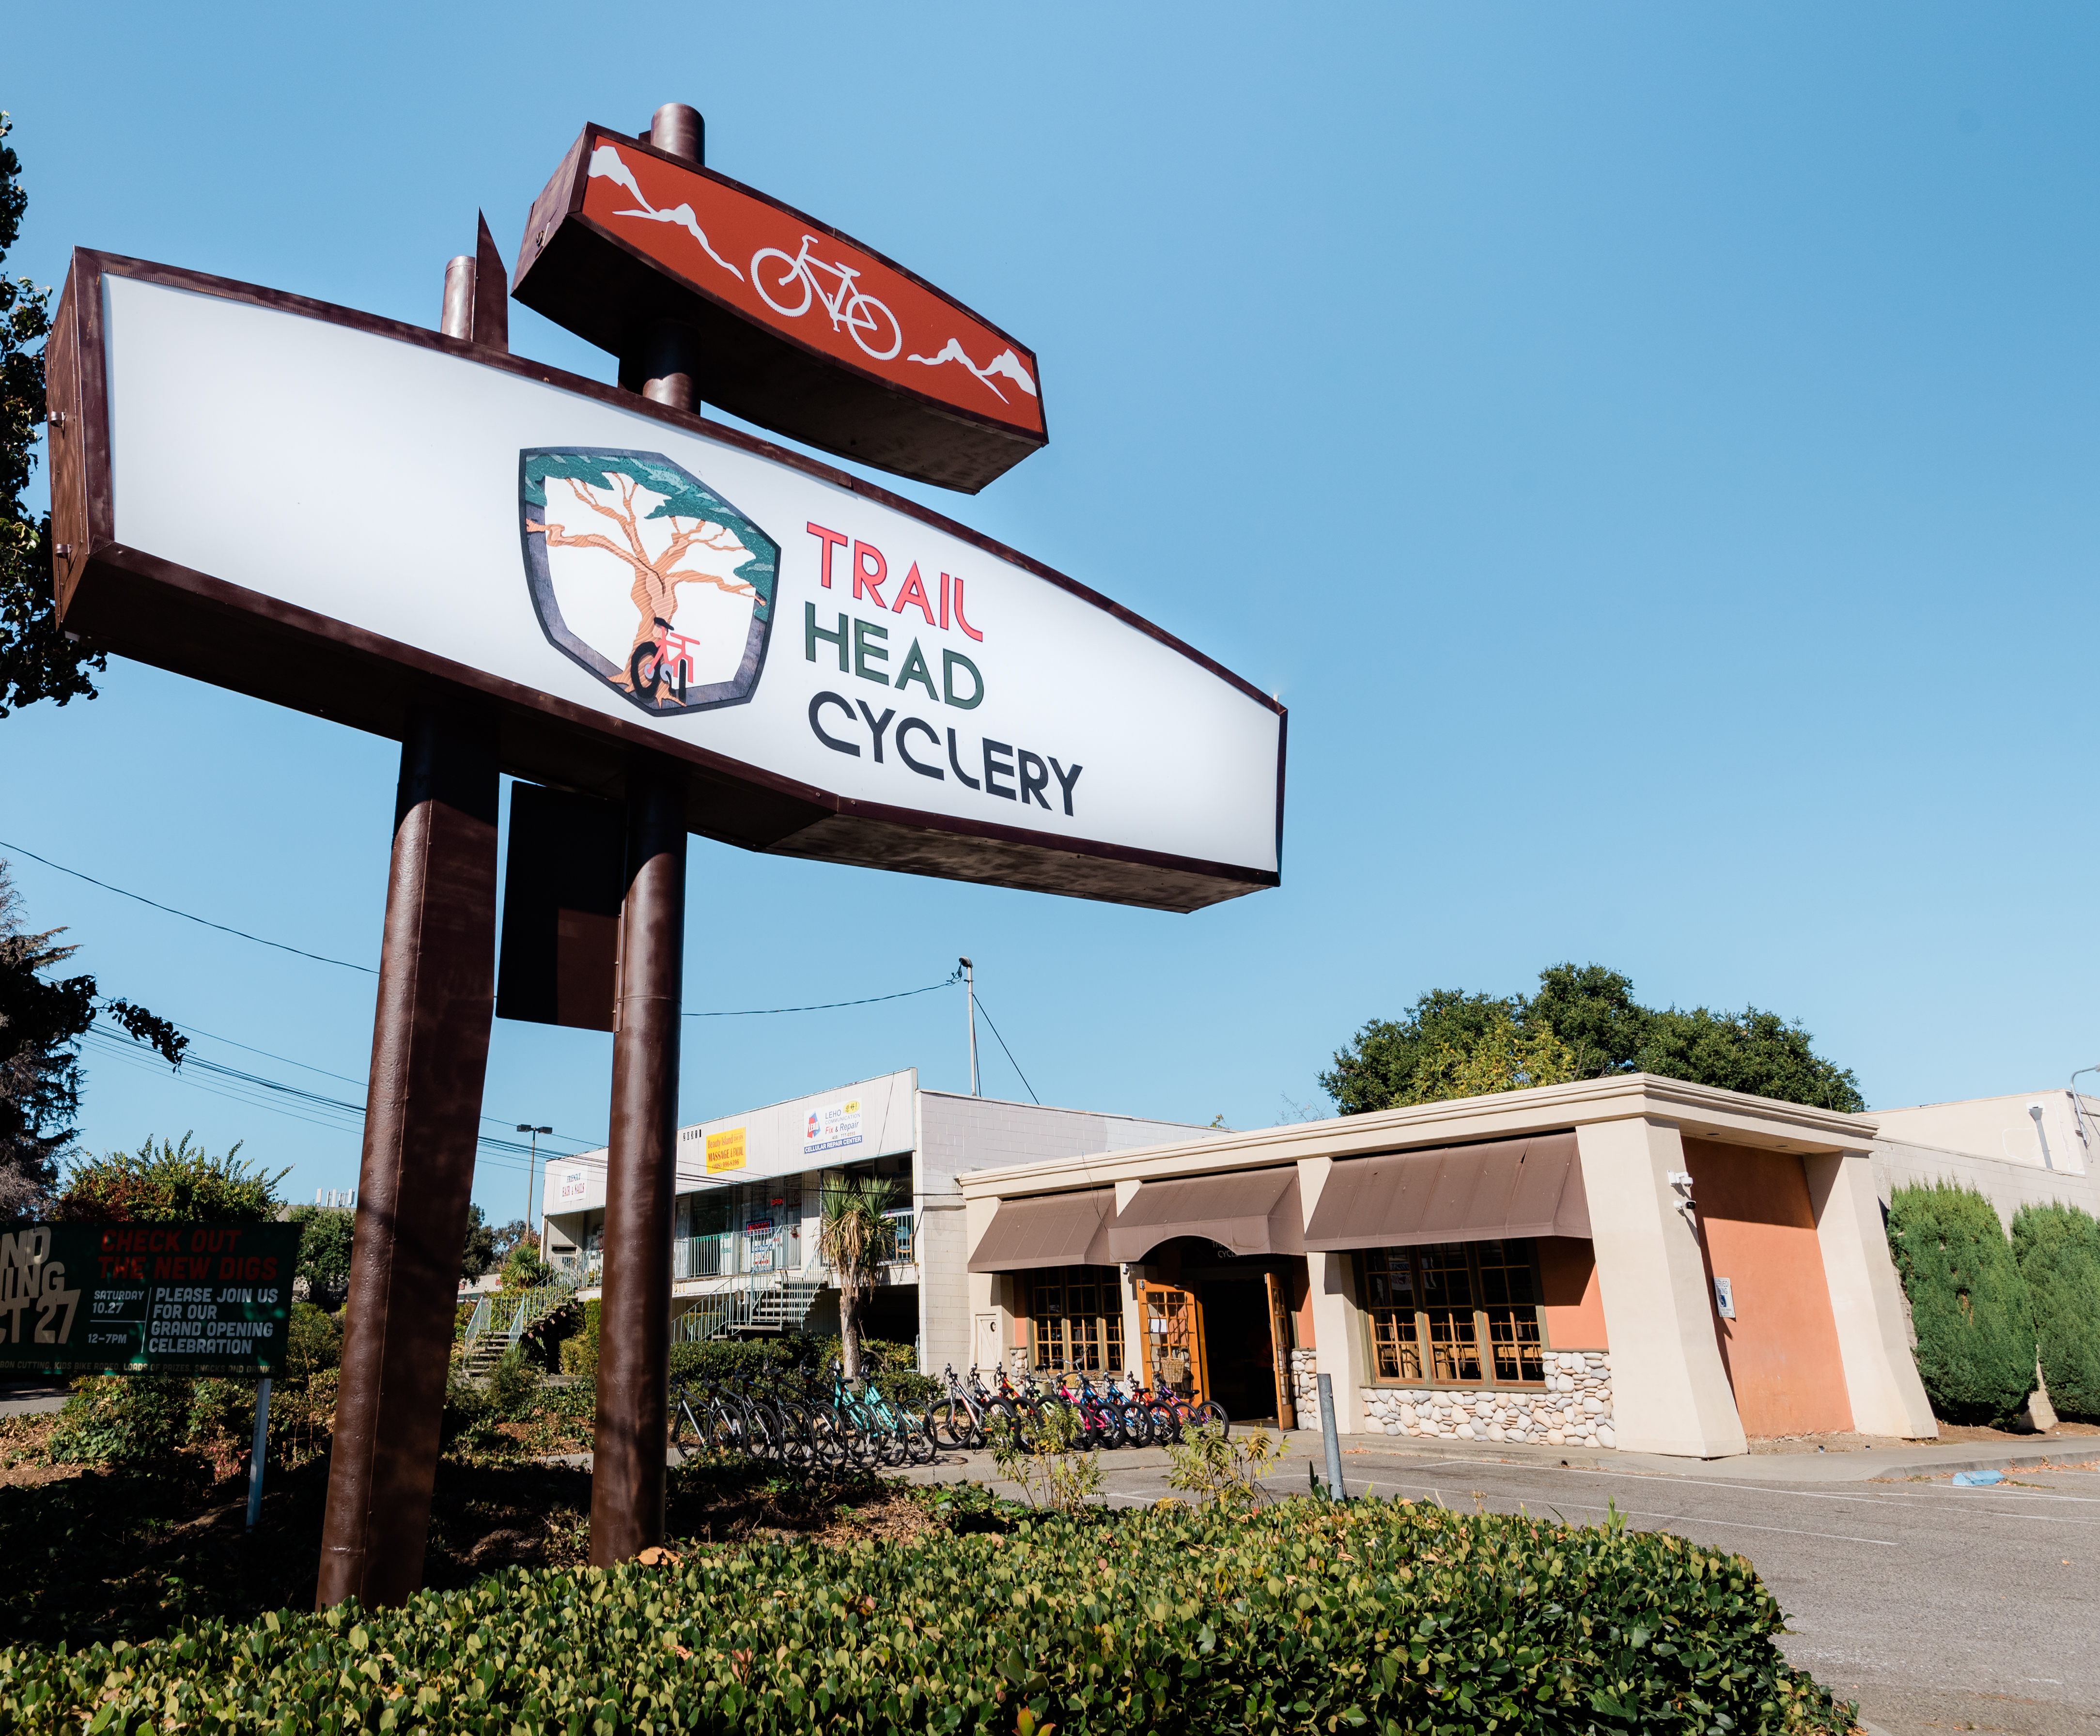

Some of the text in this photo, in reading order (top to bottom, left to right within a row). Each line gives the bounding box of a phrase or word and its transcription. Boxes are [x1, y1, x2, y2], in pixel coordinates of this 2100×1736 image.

[807, 521, 983, 642] TRAIL
[805, 601, 984, 710] HEAD
[809, 691, 1083, 817] CYCLERY
[825, 1109, 841, 1119] LEHO
[825, 1113, 860, 1125] COMMUNICATION
[840, 1120, 859, 1132] Repair
[708, 1139, 721, 1149] Beauty
[722, 1134, 733, 1146] Island
[805, 1143, 826, 1153] CELLULAR
[827, 1140, 842, 1148] REPAIR
[843, 1136, 861, 1145] CENTER
[708, 1149, 729, 1162] MASSAGE
[733, 1147, 744, 1157] FACIAL
[722, 1159, 739, 1168] 996-8396
[567, 1173, 581, 1183] FRIENDLY
[562, 1185, 570, 1197] HAIR
[575, 1182, 584, 1194] NAILS
[0, 1226, 51, 1268] ND
[100, 1229, 243, 1253] CHECK OUT
[97, 1256, 278, 1280] THE NEW DIGS
[0, 1261, 65, 1302] ING
[94, 1290, 144, 1301] SATURDAY
[156, 1287, 279, 1303] PLEASE JOIN US
[93, 1302, 124, 1314] 10.27
[153, 1304, 217, 1319] FOR OUR
[34, 1289, 81, 1344] 27
[151, 1321, 273, 1337] GRAND OPENING
[149, 1338, 252, 1354] CELEBRATION
[74, 1362, 92, 1370] BIKE
[123, 1363, 148, 1371] LOADS
[194, 1364, 226, 1373] SNACKS
[228, 1365, 244, 1373] AND
